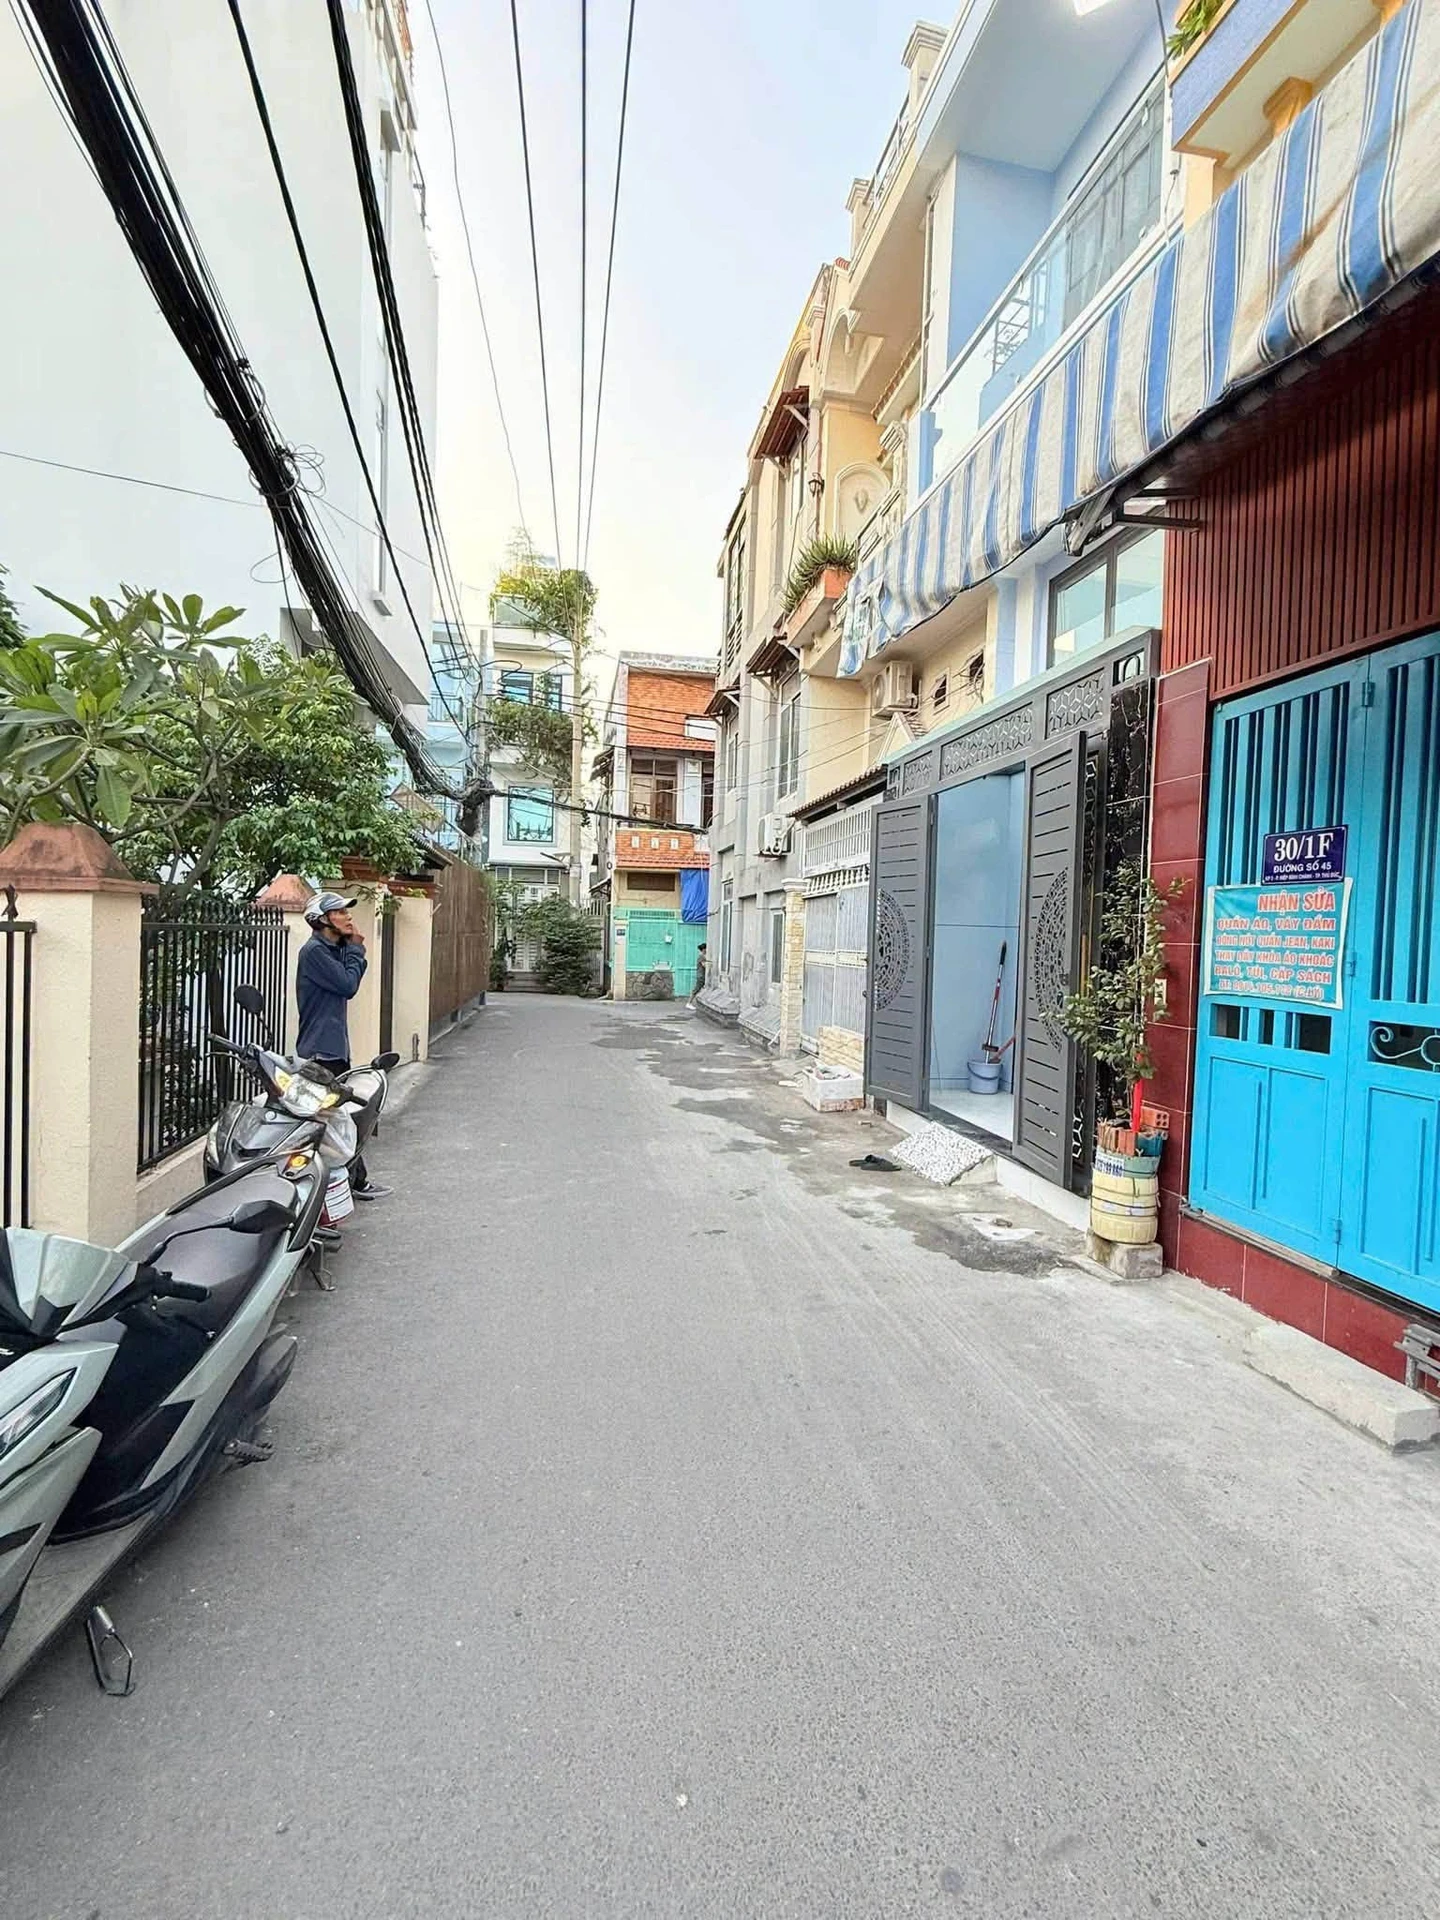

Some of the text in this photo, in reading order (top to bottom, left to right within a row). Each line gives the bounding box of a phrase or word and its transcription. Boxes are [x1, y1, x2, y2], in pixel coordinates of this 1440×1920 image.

[1274, 833, 1334, 862] 30/1F
[1306, 859, 1320, 871] SỐ
[1321, 861, 1332, 870] 45
[1257, 886, 1335, 915] NHẬN SỬA
[1311, 936, 1335, 949] KAKI
[1297, 968, 1332, 984] SÁCH
